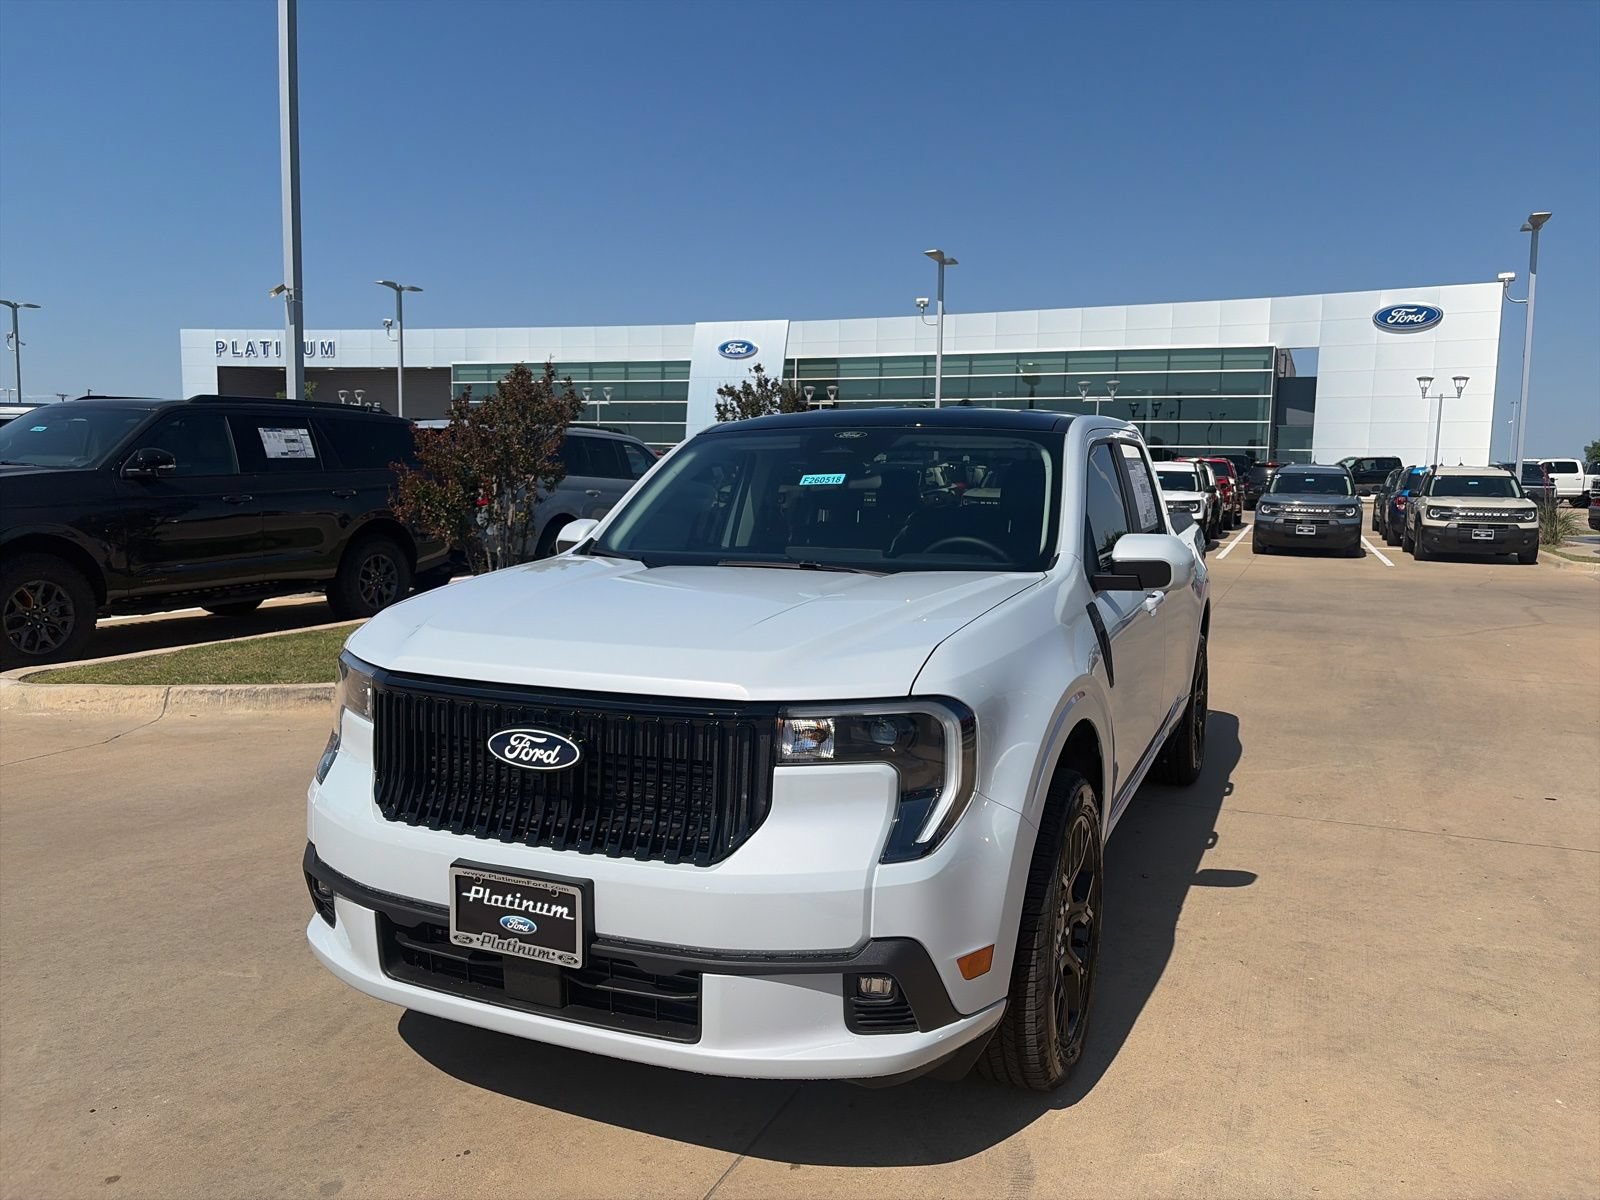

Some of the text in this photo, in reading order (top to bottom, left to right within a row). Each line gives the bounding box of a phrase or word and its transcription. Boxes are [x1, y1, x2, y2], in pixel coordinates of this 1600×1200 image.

[1387, 307, 1428, 324] Ford
[215, 340, 336, 358] PLATIUM
[724, 342, 748, 354] Ford
[802, 476, 842, 484] F260518
[504, 733, 562, 765] Ford
[462, 869, 570, 893] www.PlatinumFord.com
[461, 885, 575, 921] Platinum
[506, 917, 530, 933] Ford
[480, 934, 556, 961] Platinum
